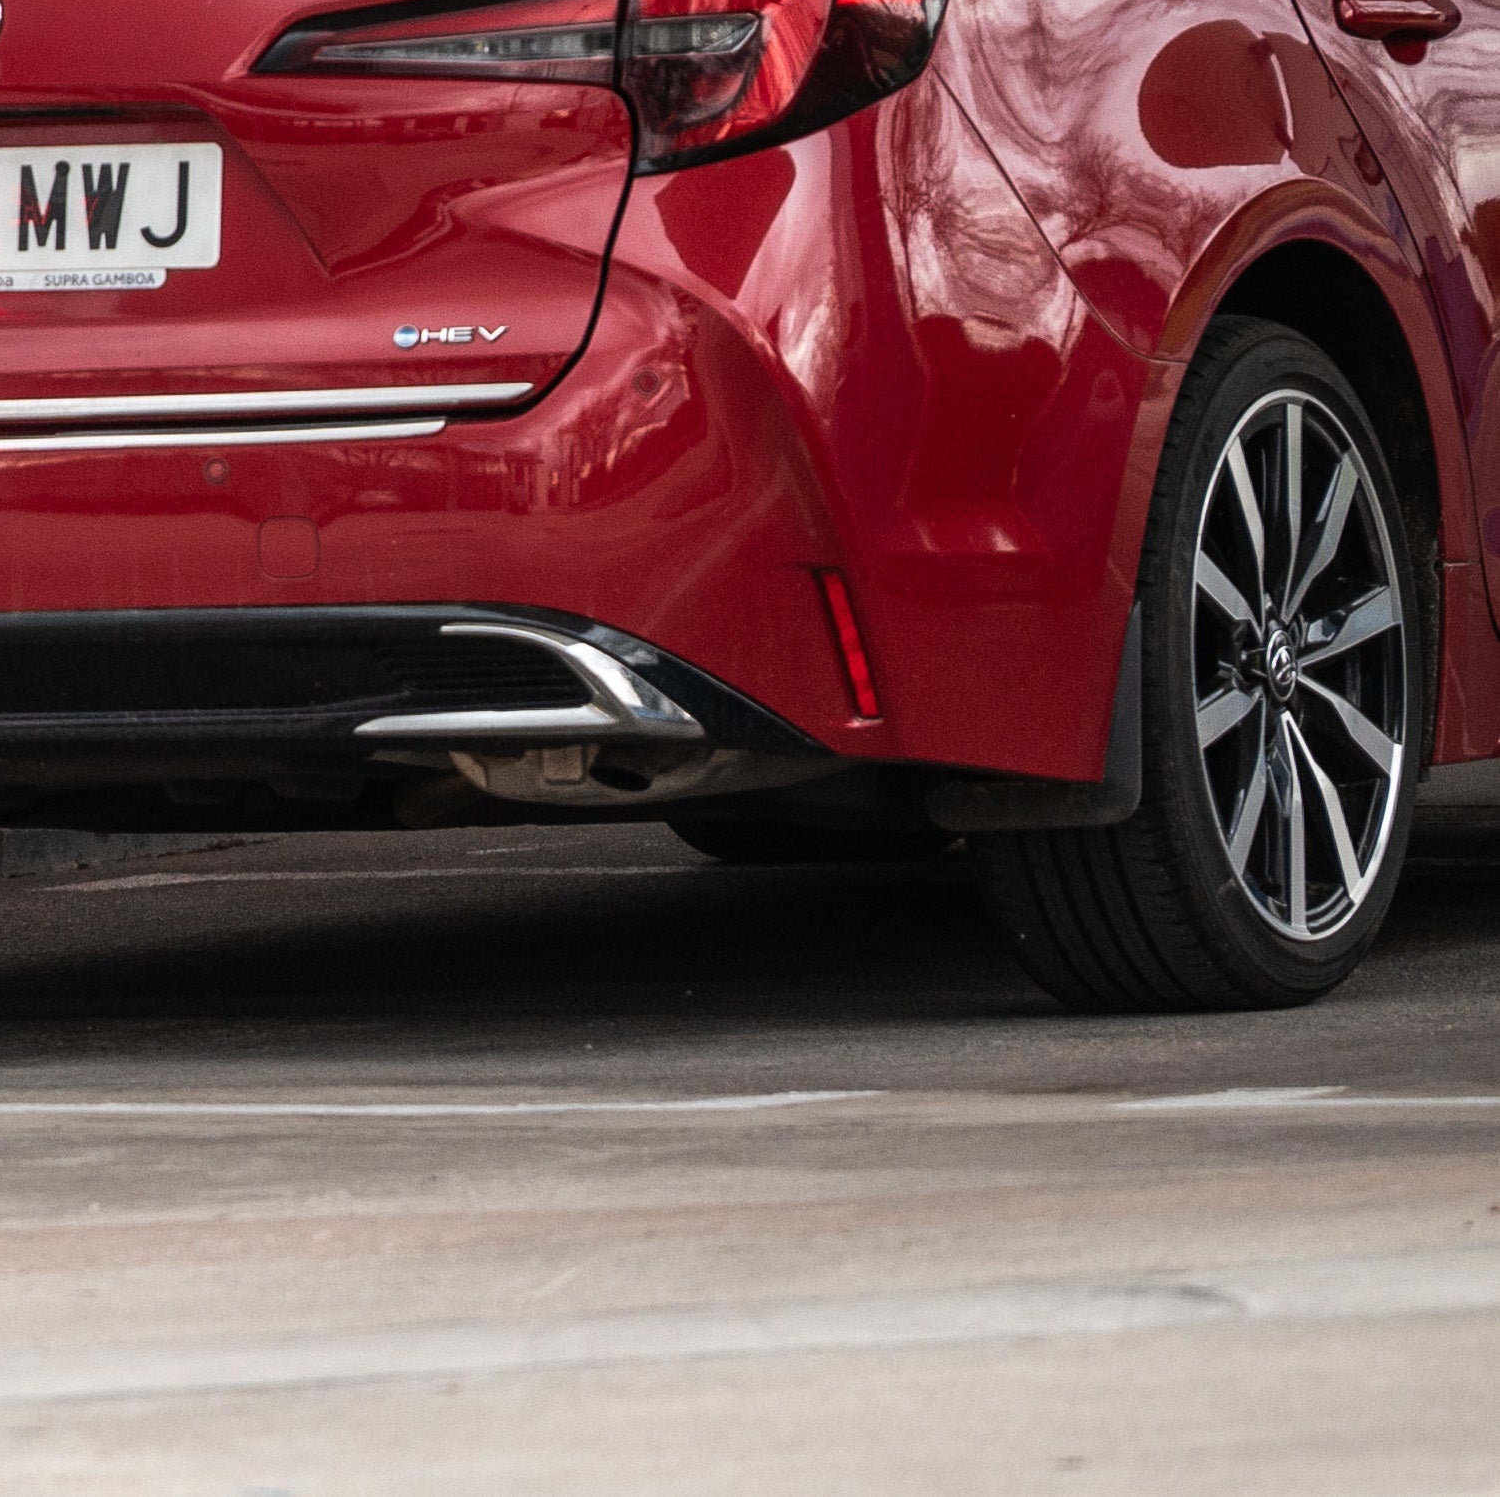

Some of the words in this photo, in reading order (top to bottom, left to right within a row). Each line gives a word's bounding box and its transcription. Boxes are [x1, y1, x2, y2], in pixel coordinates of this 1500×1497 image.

[17, 160, 190, 253] MWJ
[44, 274, 89, 287] SUPRA
[92, 272, 156, 287] GAMBOA
[420, 325, 509, 343] HEV
